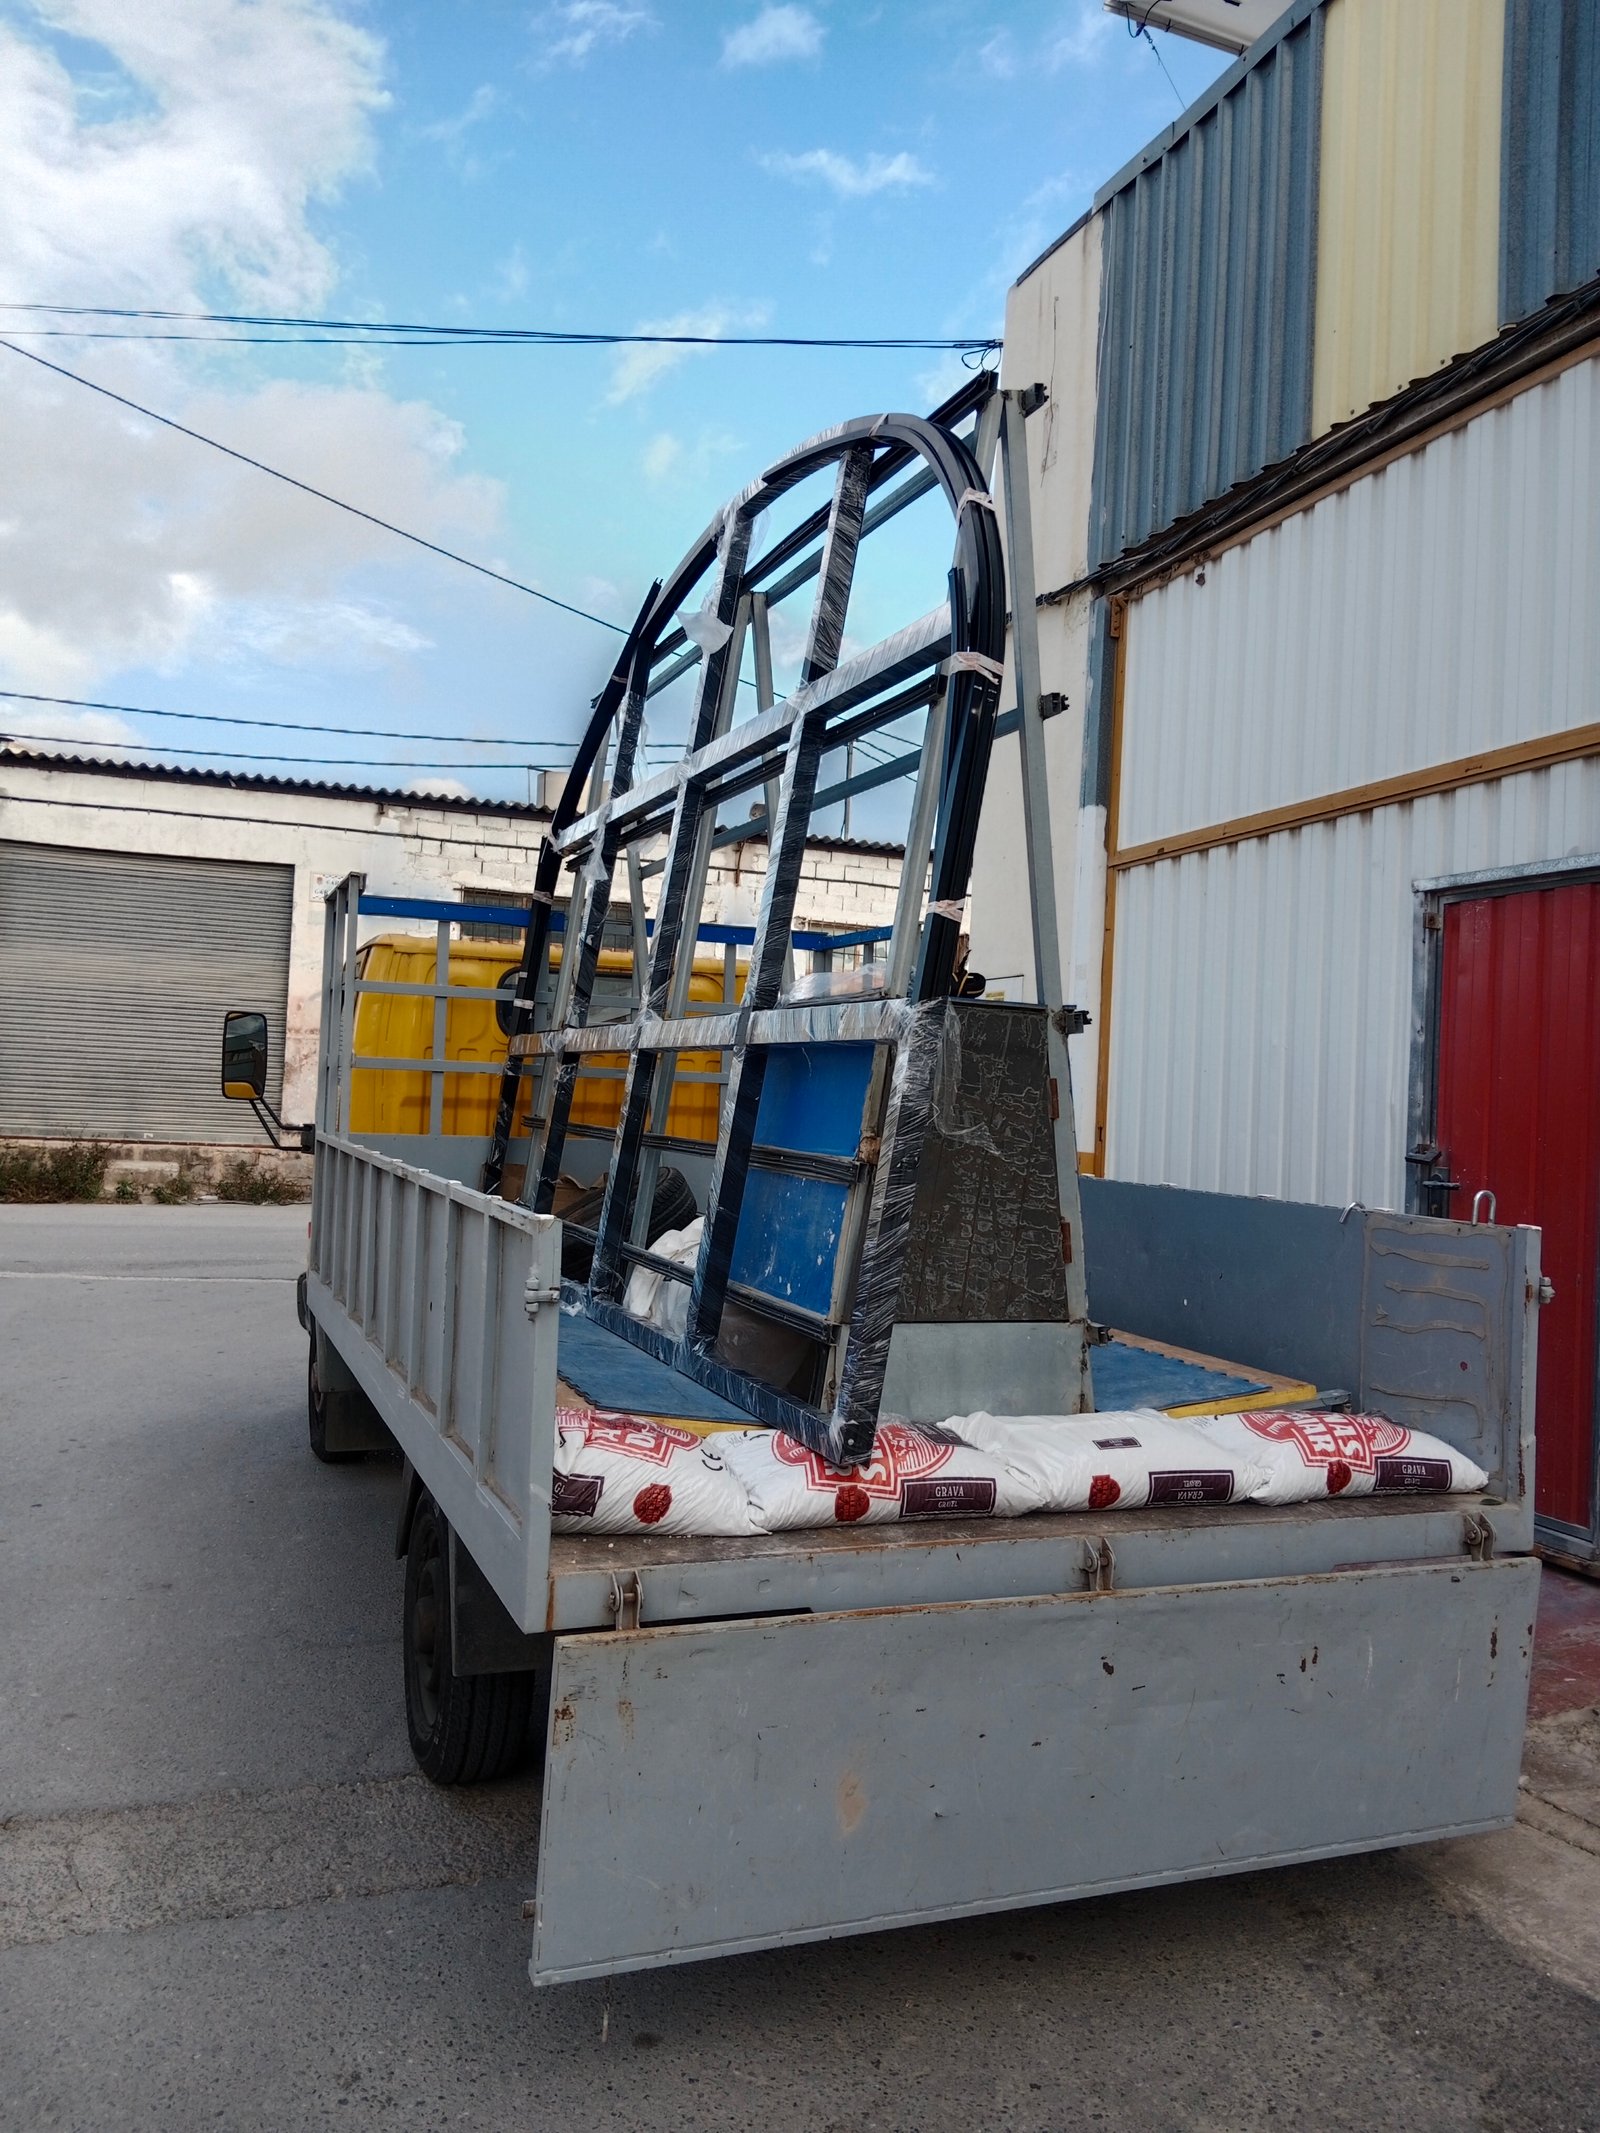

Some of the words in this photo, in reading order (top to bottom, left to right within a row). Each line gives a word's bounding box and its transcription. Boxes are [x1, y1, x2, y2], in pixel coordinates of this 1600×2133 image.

[1401, 1464, 1426, 1475] GRAVA
[935, 1485, 964, 1497] GRAVA
[1177, 1490, 1204, 1500] GRAVA
